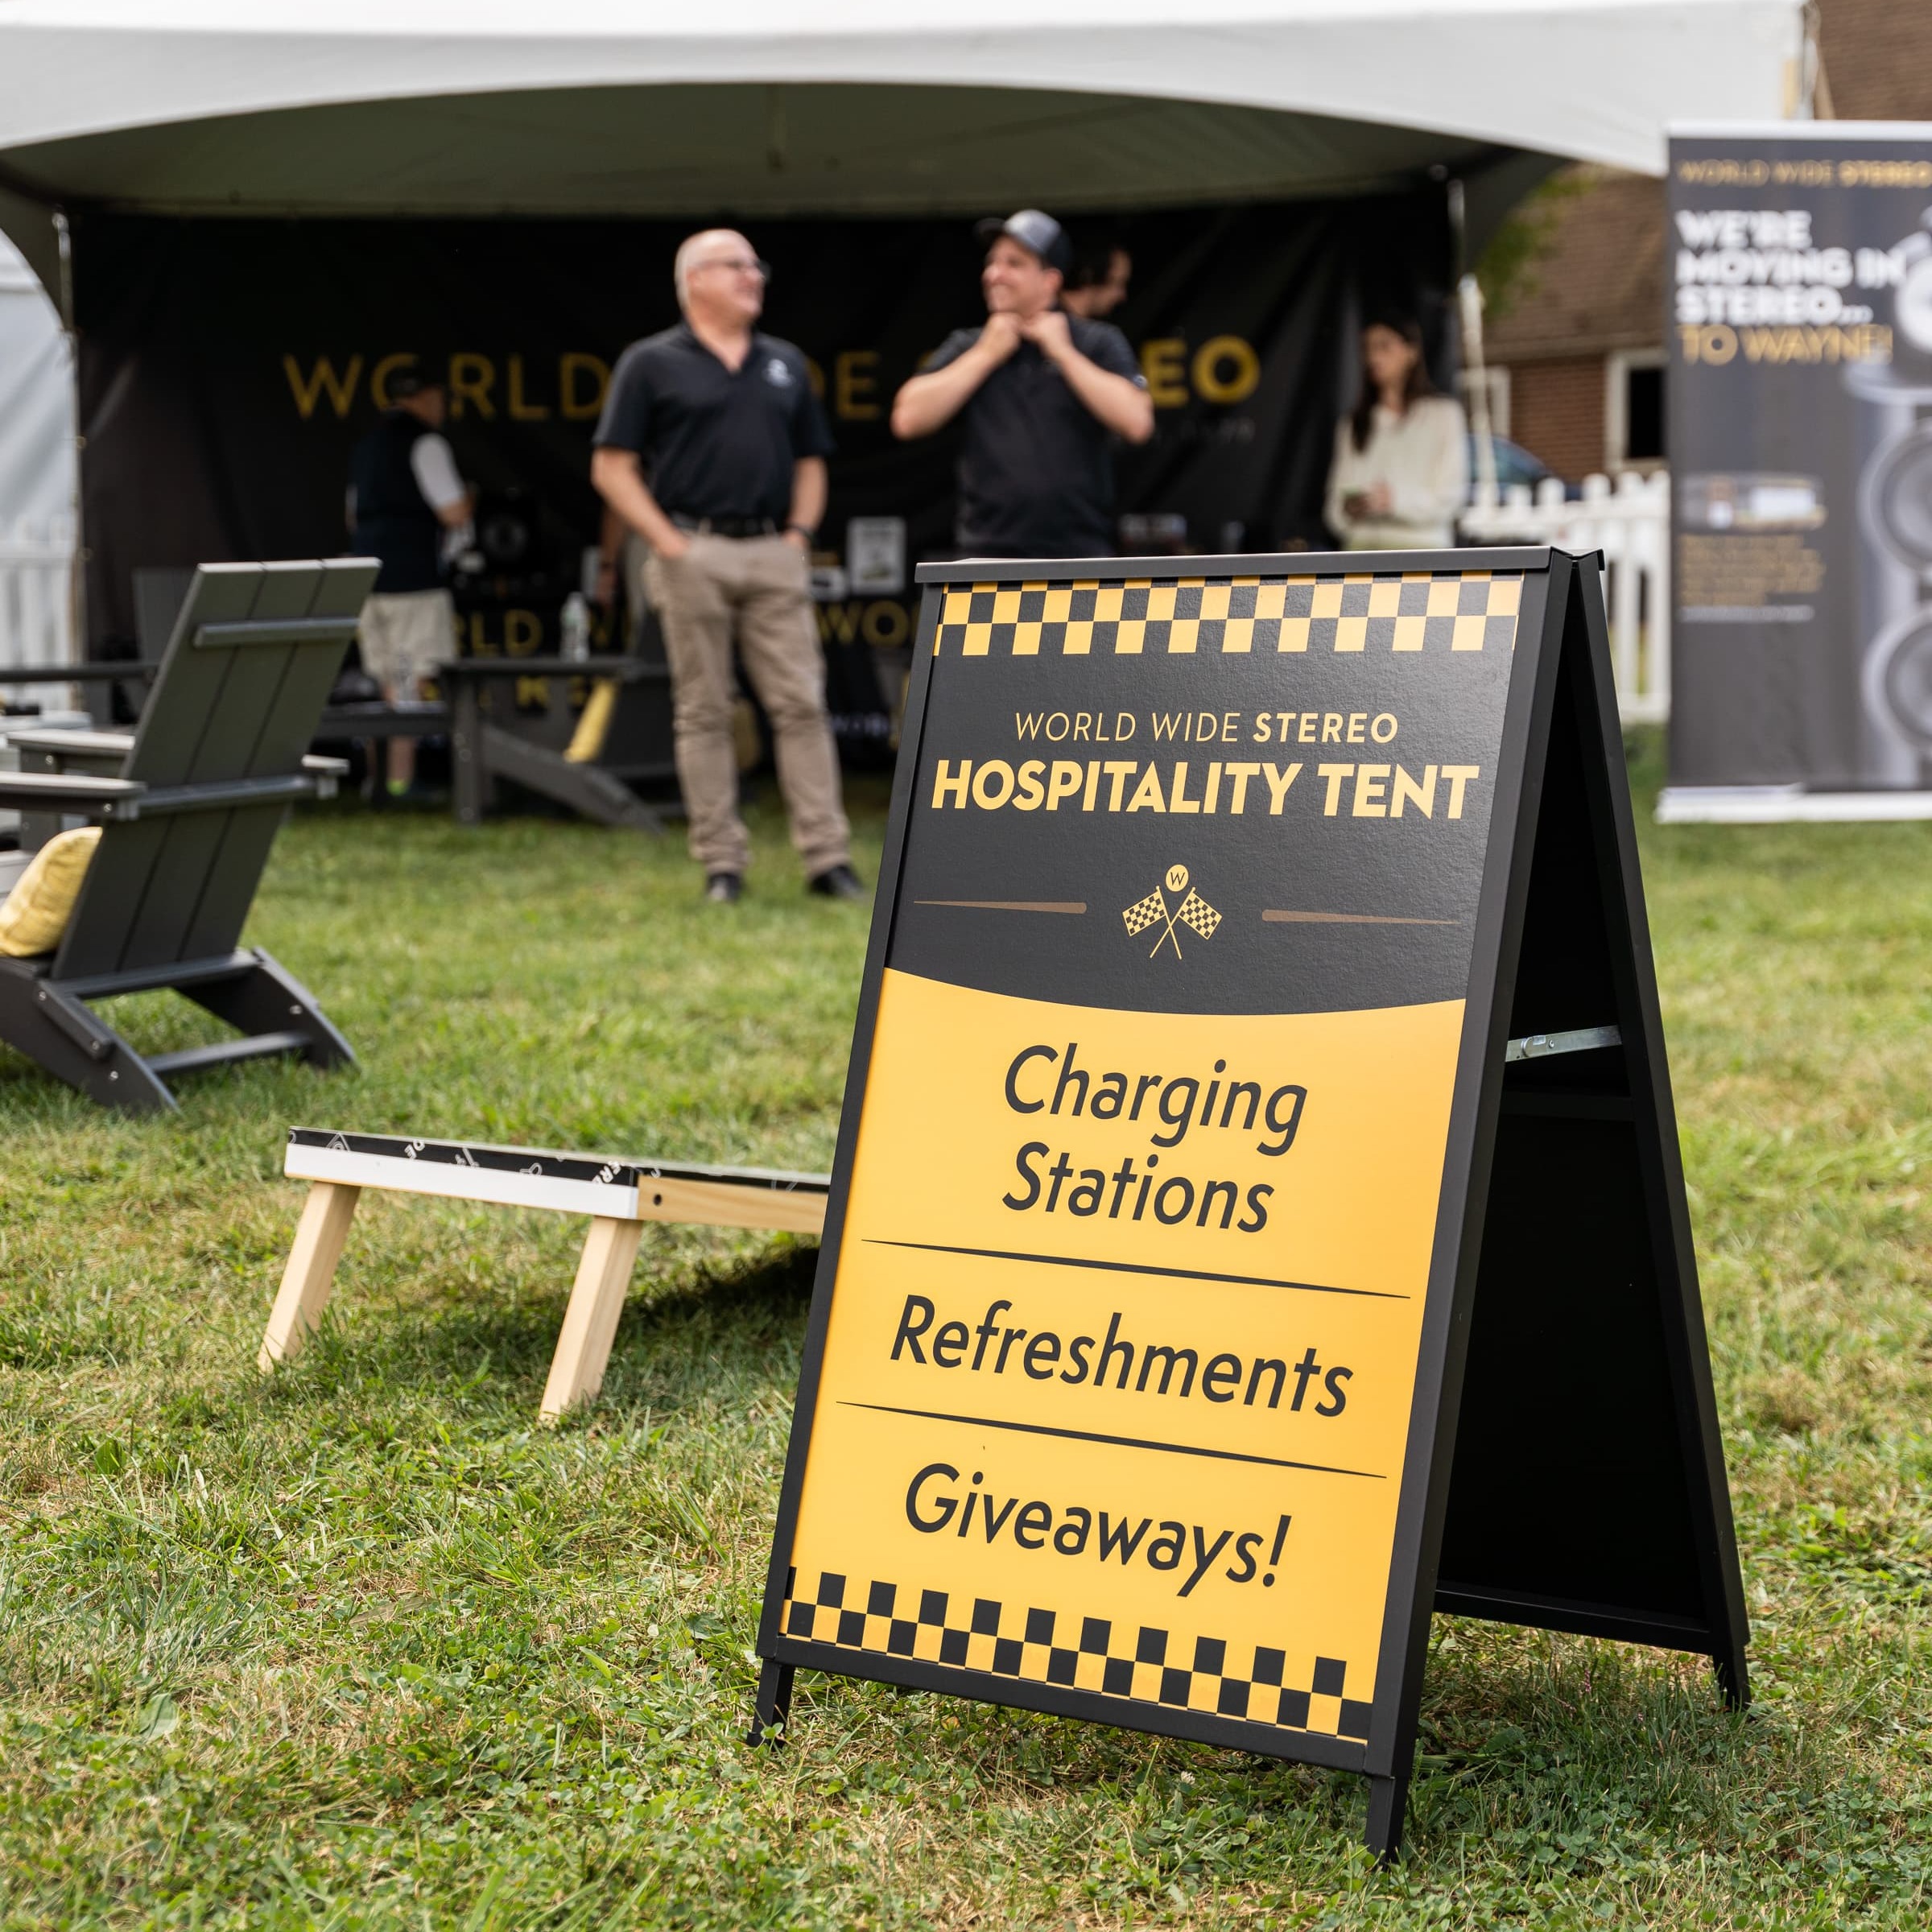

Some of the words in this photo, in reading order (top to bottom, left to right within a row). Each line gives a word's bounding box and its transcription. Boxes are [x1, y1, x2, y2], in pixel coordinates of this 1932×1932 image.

[1675, 247, 1853, 288] MOVING
[1675, 324, 1738, 365] TO
[1016, 712, 1136, 741] WORLD
[1152, 712, 1241, 742] WIDE
[1253, 712, 1398, 744] STEREO
[931, 760, 1303, 815] HOSPITALITY
[1317, 764, 1480, 819] TENT
[1170, 872, 1186, 886] W
[1005, 1042, 1308, 1157] Charging
[1002, 1141, 1275, 1233] Stations
[890, 1294, 1354, 1417] Refreshments
[905, 1463, 1292, 1597] Giveaways!
